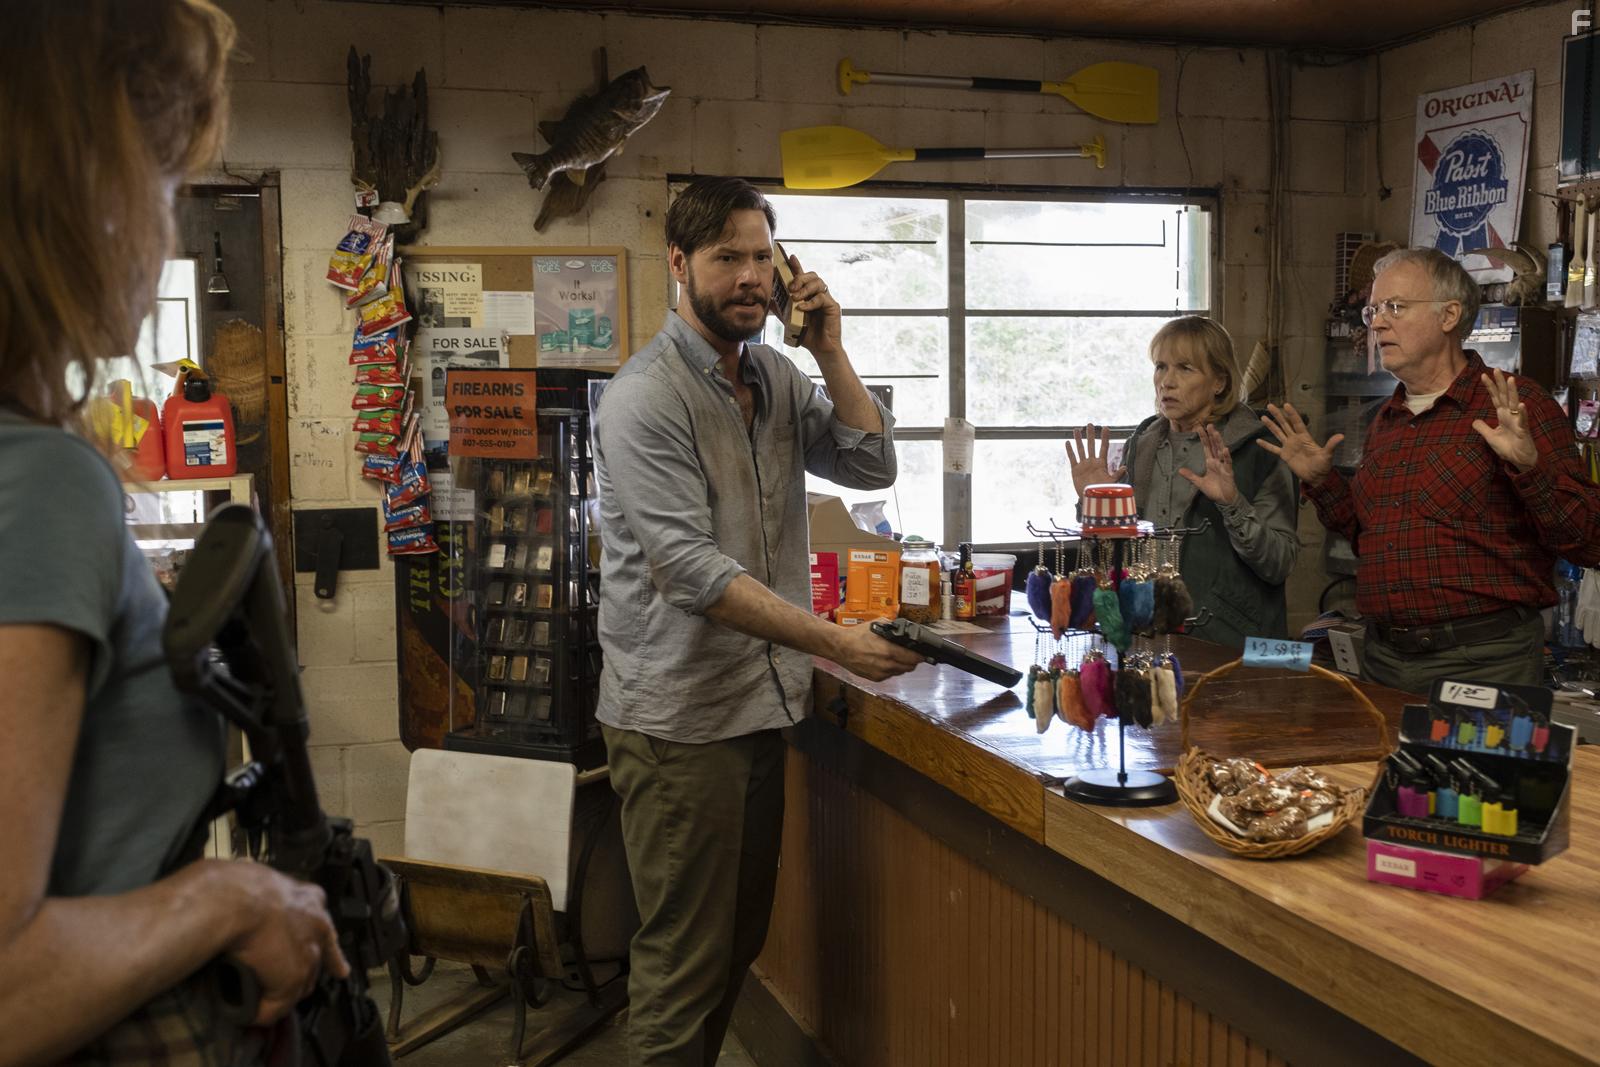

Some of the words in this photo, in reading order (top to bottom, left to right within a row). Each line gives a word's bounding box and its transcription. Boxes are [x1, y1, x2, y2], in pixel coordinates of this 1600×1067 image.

[1424, 81, 1525, 119] ORIGINAL
[1444, 150, 1493, 184] Pabst
[1425, 189, 1456, 214] Blue
[1457, 183, 1507, 210] Ribbon
[1454, 211, 1473, 220] BEER
[416, 271, 476, 283] ISSING:
[558, 290, 596, 301] Works!
[432, 337, 460, 349] FOR
[464, 337, 497, 349] SALE
[452, 382, 525, 397] FIREARMS
[454, 405, 481, 419] FOR
[484, 406, 523, 420] SALE
[471, 427, 499, 436] TOUCH
[397, 531, 426, 543] Vinegar
[1386, 825, 1438, 845] TORCH
[1442, 833, 1510, 856] LIGHTER
